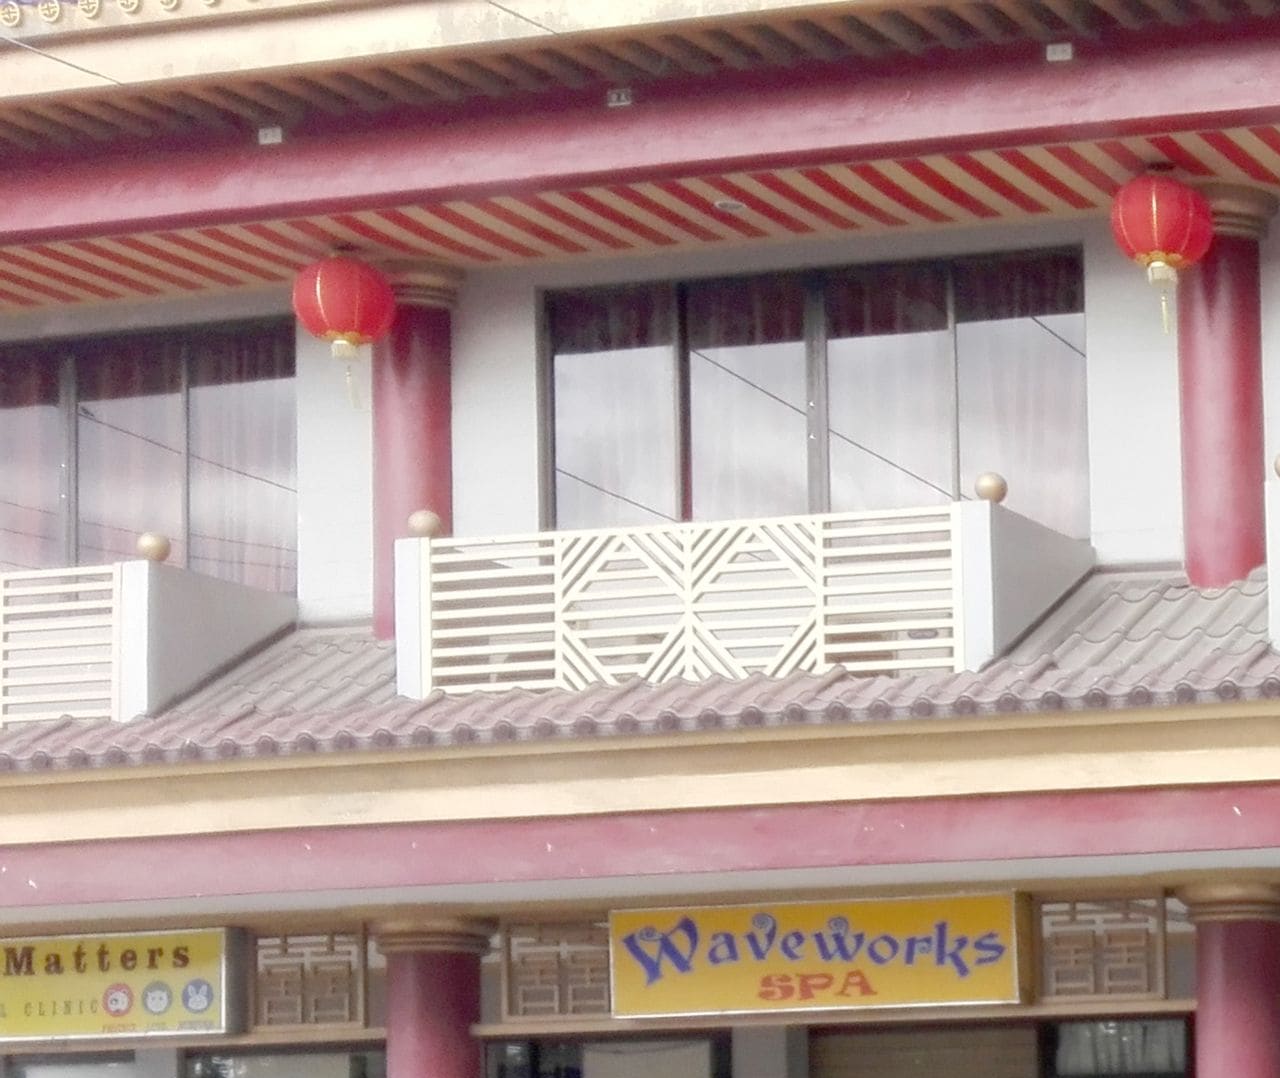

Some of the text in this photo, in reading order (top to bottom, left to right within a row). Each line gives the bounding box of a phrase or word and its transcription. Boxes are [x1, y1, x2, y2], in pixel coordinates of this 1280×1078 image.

[3, 943, 190, 977] Matters
[621, 912, 1007, 987] Waveworks
[757, 968, 879, 1001] SPA
[24, 1000, 98, 1018] CLINIC
